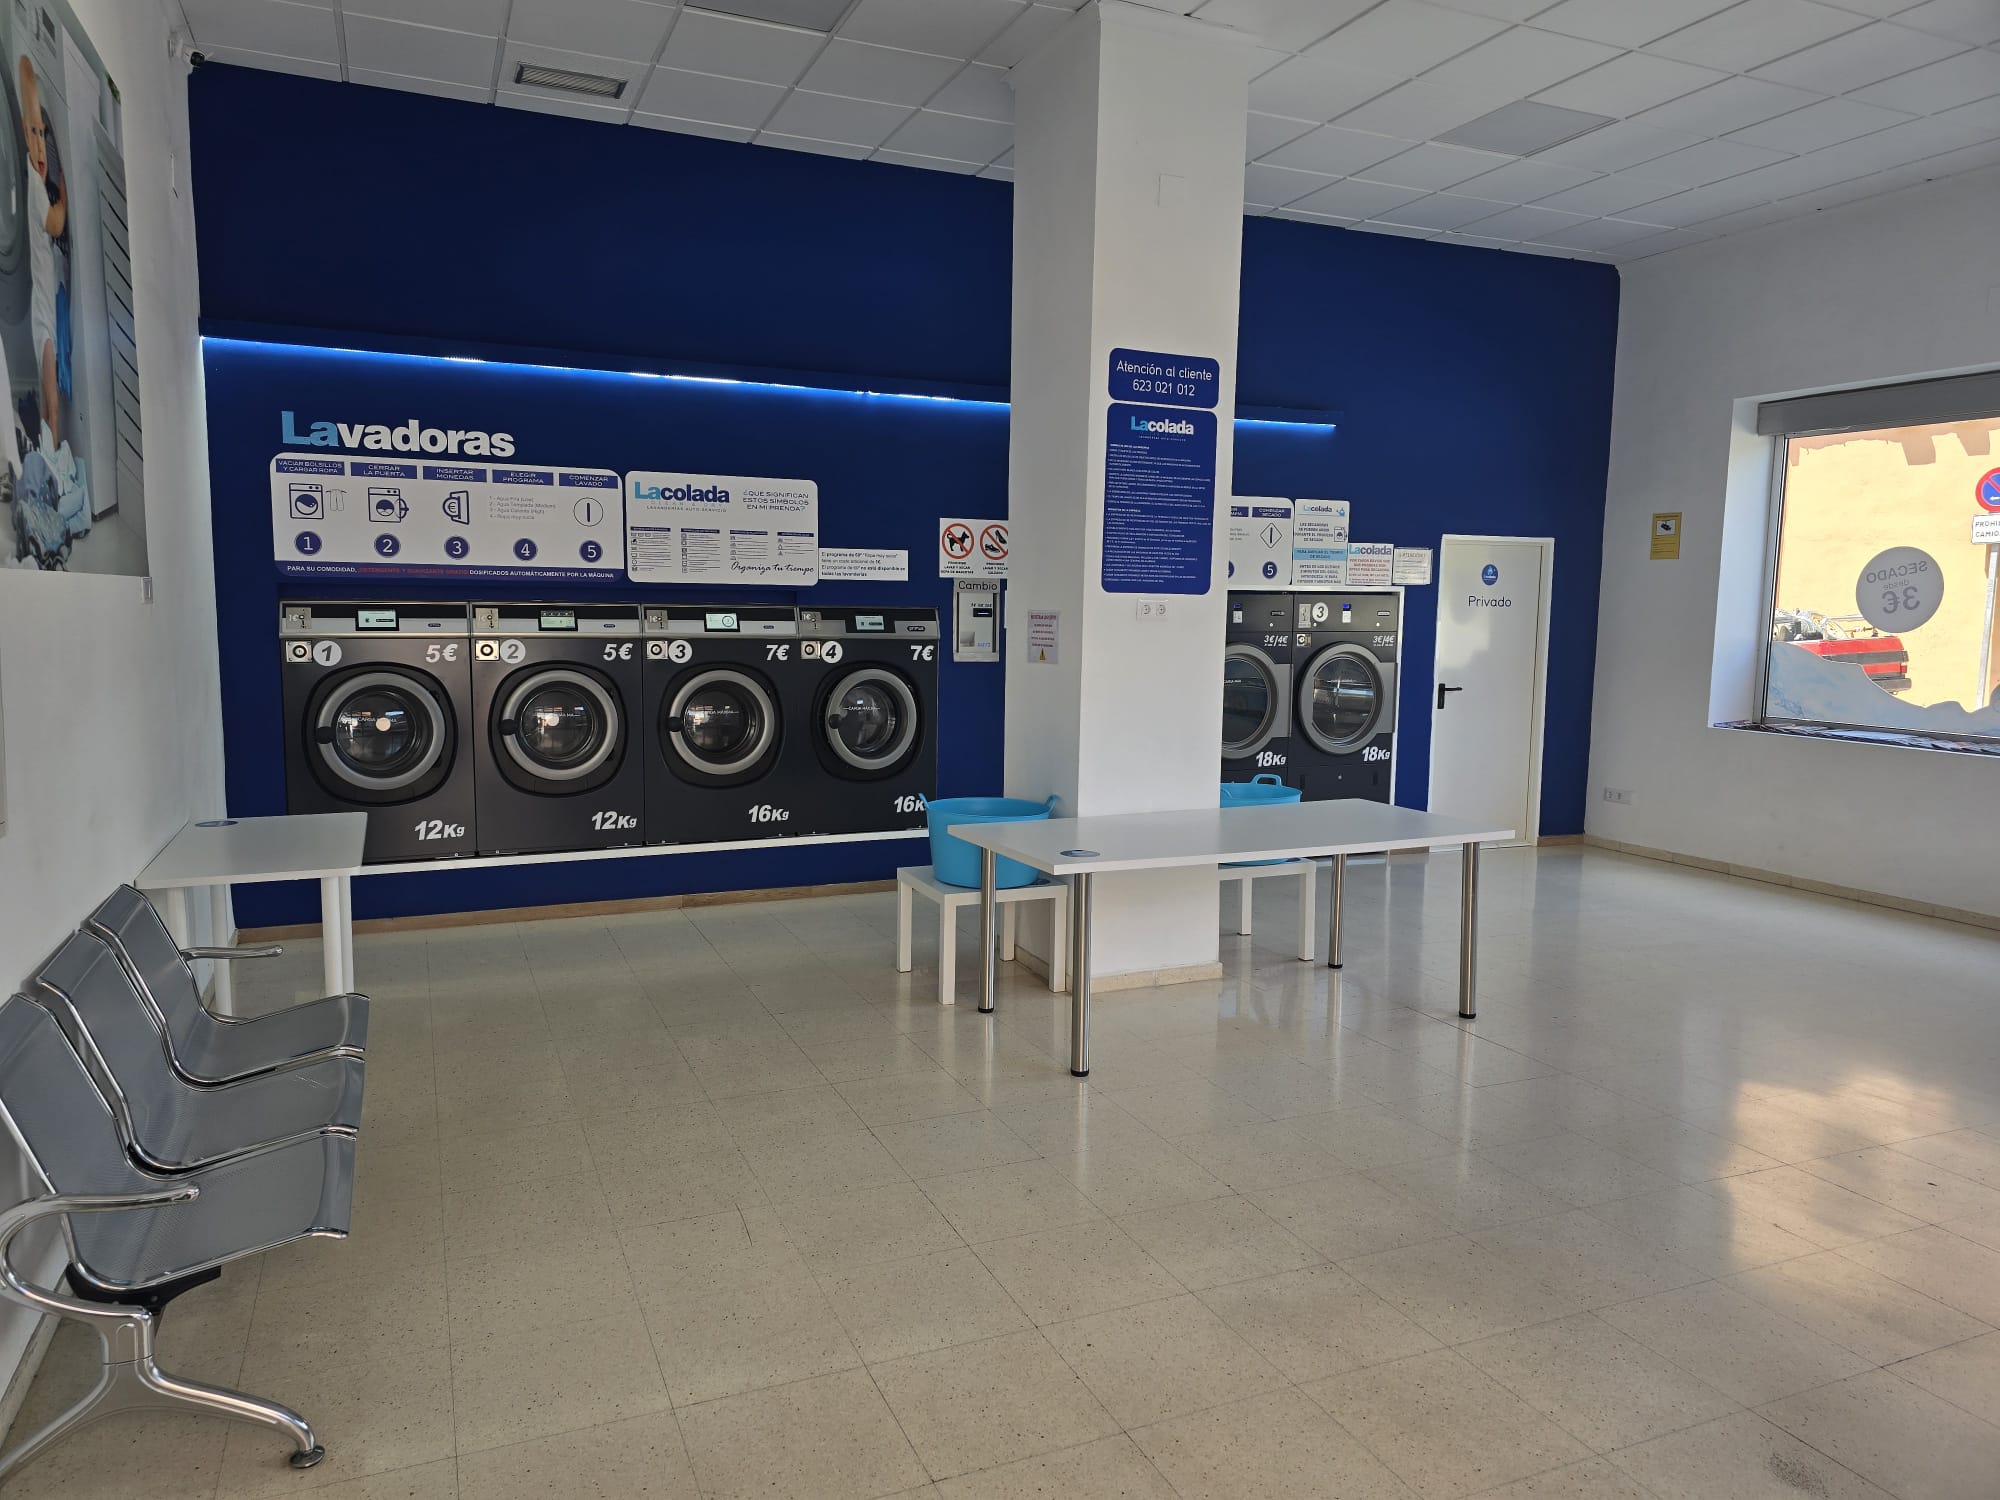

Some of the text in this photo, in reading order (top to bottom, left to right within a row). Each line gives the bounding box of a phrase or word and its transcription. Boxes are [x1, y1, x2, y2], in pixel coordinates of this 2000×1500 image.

[1117, 360, 1212, 380] Atención al cliente
[1133, 379, 1195, 396] 623 021 012
[1131, 416, 1194, 435] Lacolada
[281, 411, 515, 457] Lavadoras
[635, 482, 730, 503] Lacolada
[1976, 530, 2000, 538] CAMIO
[303, 537, 314, 551] 1
[383, 539, 393, 553] 2
[452, 541, 462, 554] 3
[520, 543, 530, 556] 4
[587, 545, 597, 558] 5
[1348, 544, 1392, 555] Lacolada
[1267, 565, 1274, 576] 5
[958, 580, 998, 591] Cambio
[1468, 595, 1512, 608] Privado
[1316, 607, 1324, 618] 3
[321, 644, 333, 662] 1
[425, 643, 458, 663] 5€
[507, 643, 519, 660] 2
[602, 643, 634, 661] 5€
[675, 644, 686, 659] 3
[766, 644, 790, 661] 7€
[826, 645, 837, 659] 4
[911, 645, 935, 661] 7€
[1256, 751, 1287, 767] 18Kg
[1362, 746, 1391, 762] 18Kg
[893, 795, 925, 813] 16K
[590, 810, 637, 832] 12Kg
[748, 804, 789, 824] 16Kg
[414, 819, 465, 842] 12Kg
